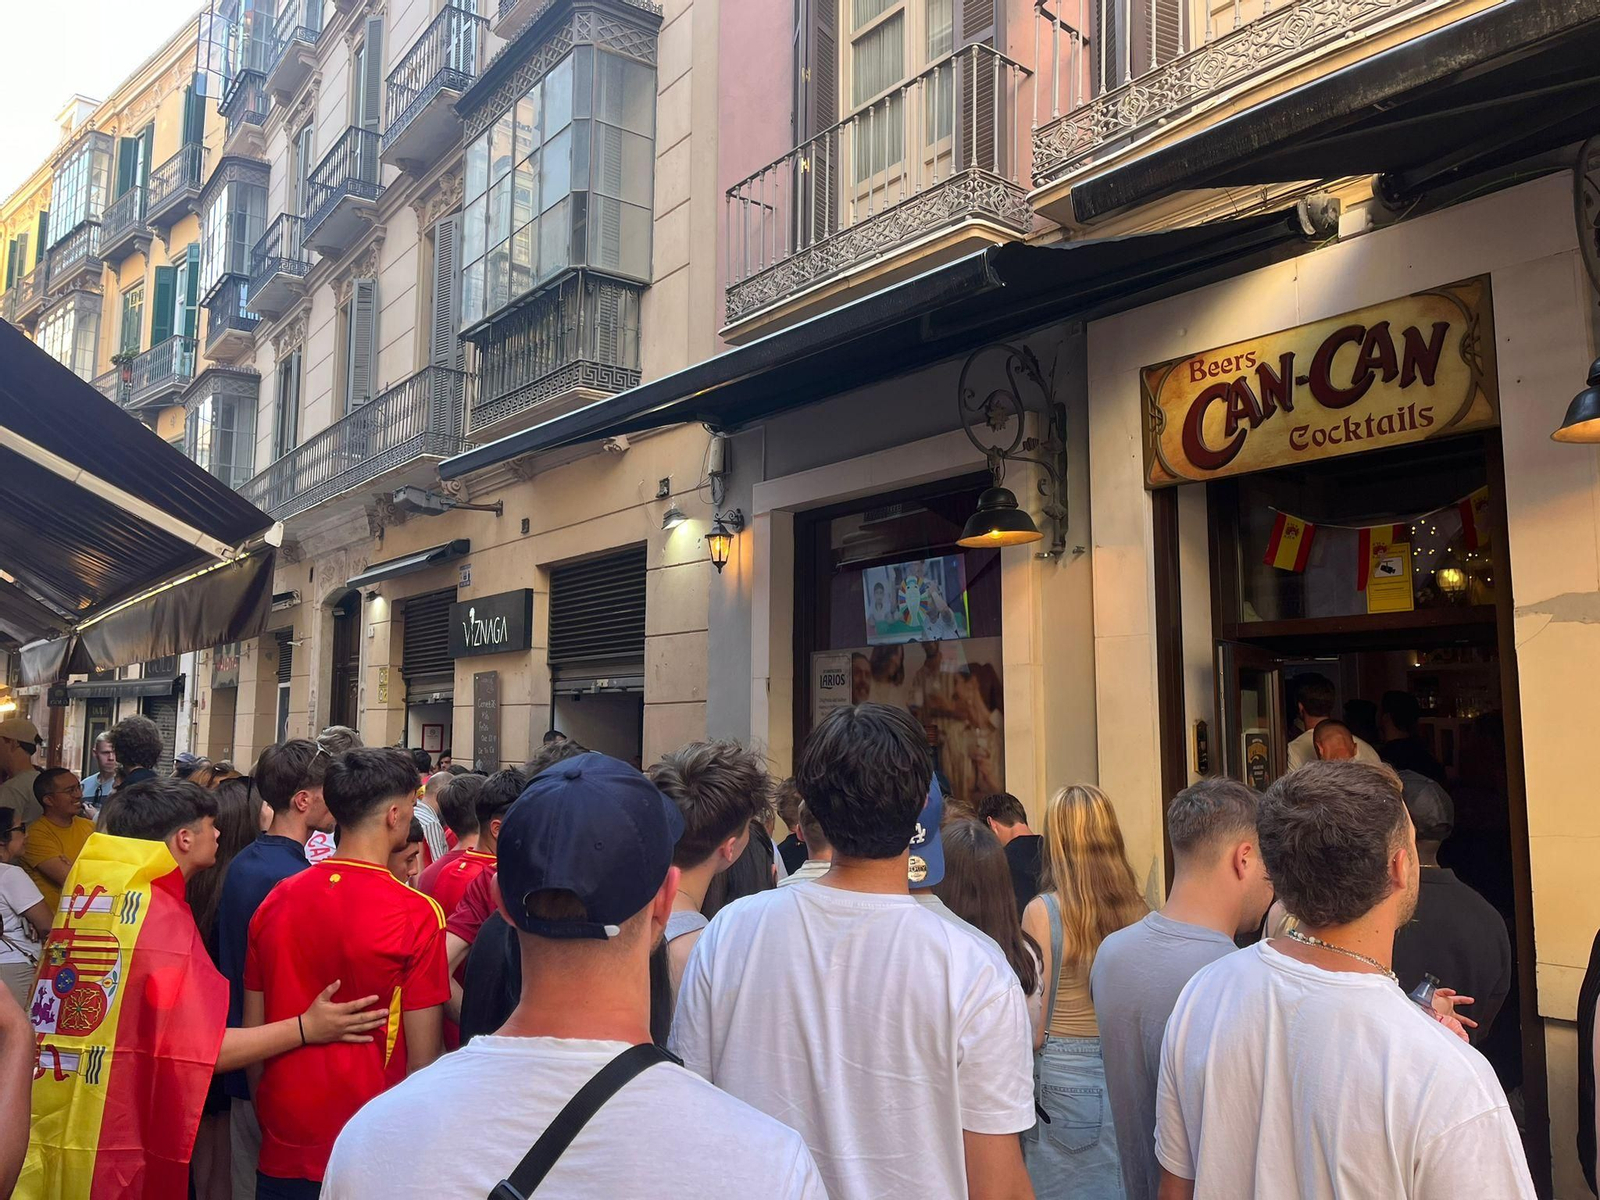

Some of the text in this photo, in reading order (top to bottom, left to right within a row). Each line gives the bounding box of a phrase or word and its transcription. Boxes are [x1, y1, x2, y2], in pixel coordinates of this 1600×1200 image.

[1189, 350, 1258, 384] Beers
[1182, 320, 1450, 471] CAN-CAN
[1289, 402, 1436, 452] Cocktails
[819, 673, 846, 690] LARIOS
[307, 833, 331, 863] CA
